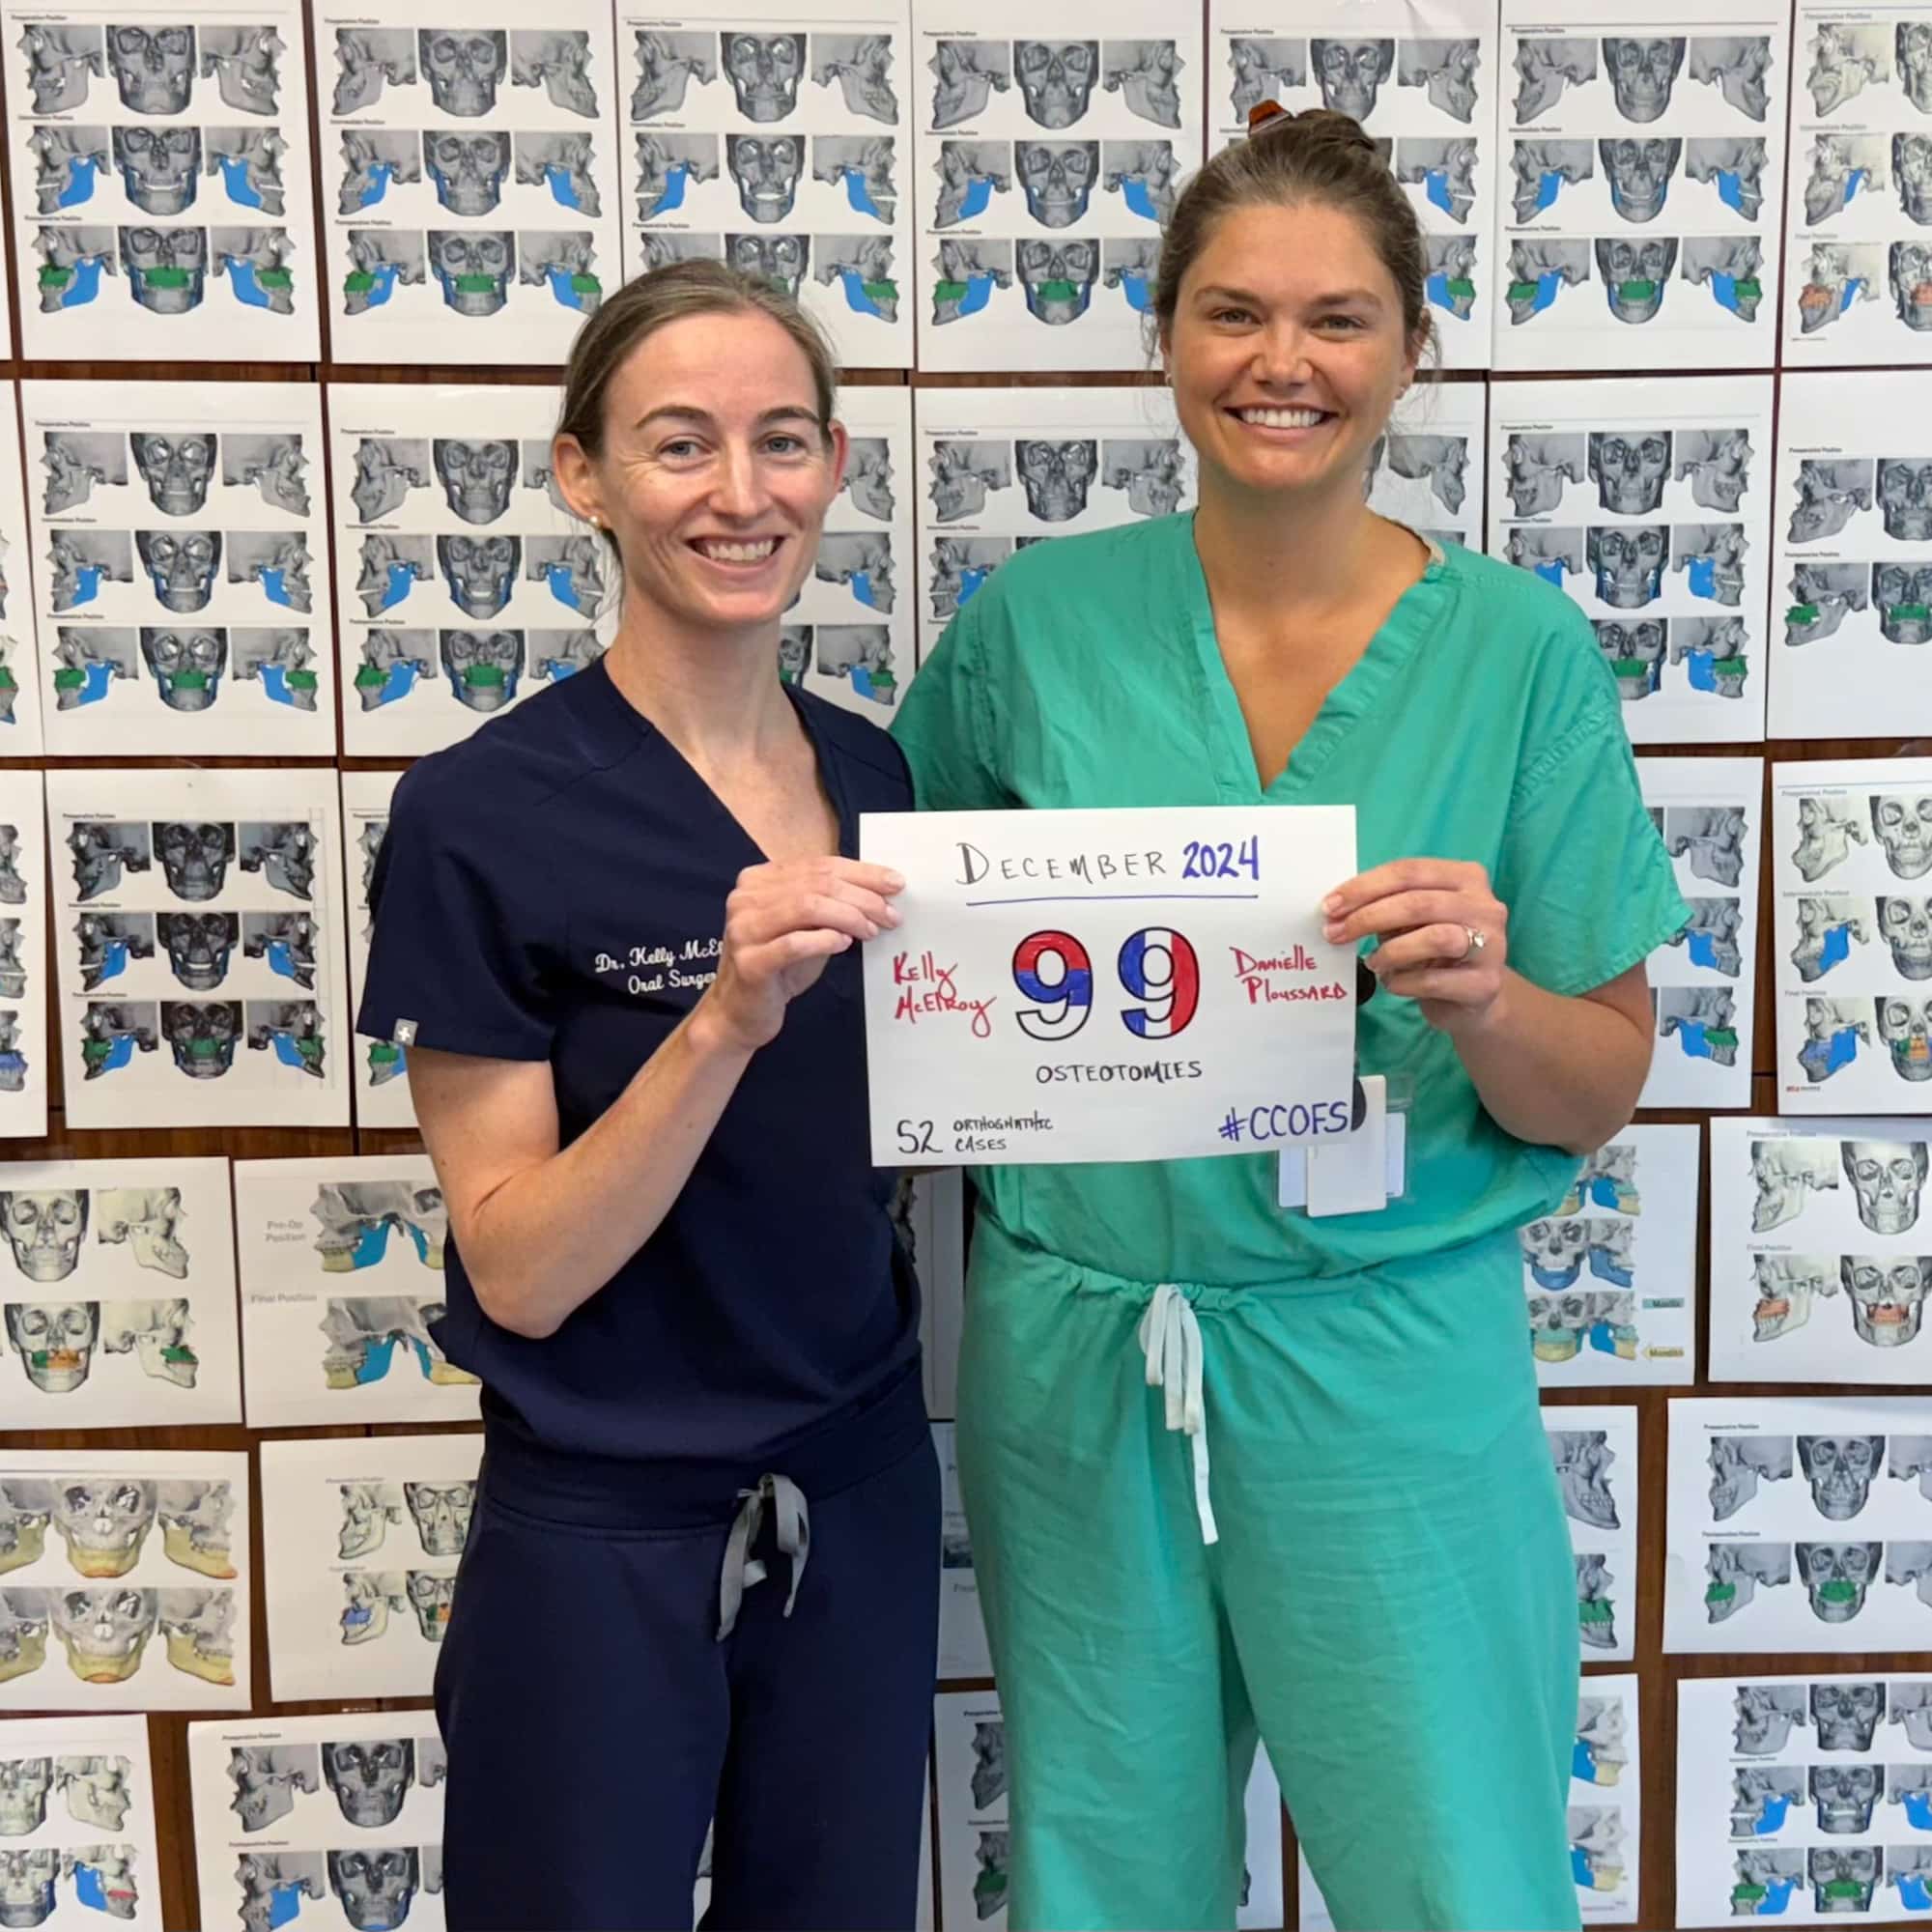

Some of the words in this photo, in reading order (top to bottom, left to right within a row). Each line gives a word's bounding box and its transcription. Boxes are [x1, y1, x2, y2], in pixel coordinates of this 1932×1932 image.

[955, 841, 1167, 886] DECEMBER
[1181, 834, 1260, 881] 2024
[595, 952, 626, 973] Dr.
[629, 946, 675, 968] Kelly
[628, 974, 665, 995] Oral
[1036, 1061, 1204, 1085] OSTEOTOMIES
[1218, 1100, 1349, 1143] #CCOFS
[896, 1119, 944, 1154] 52
[954, 1135, 1008, 1154] CASES
